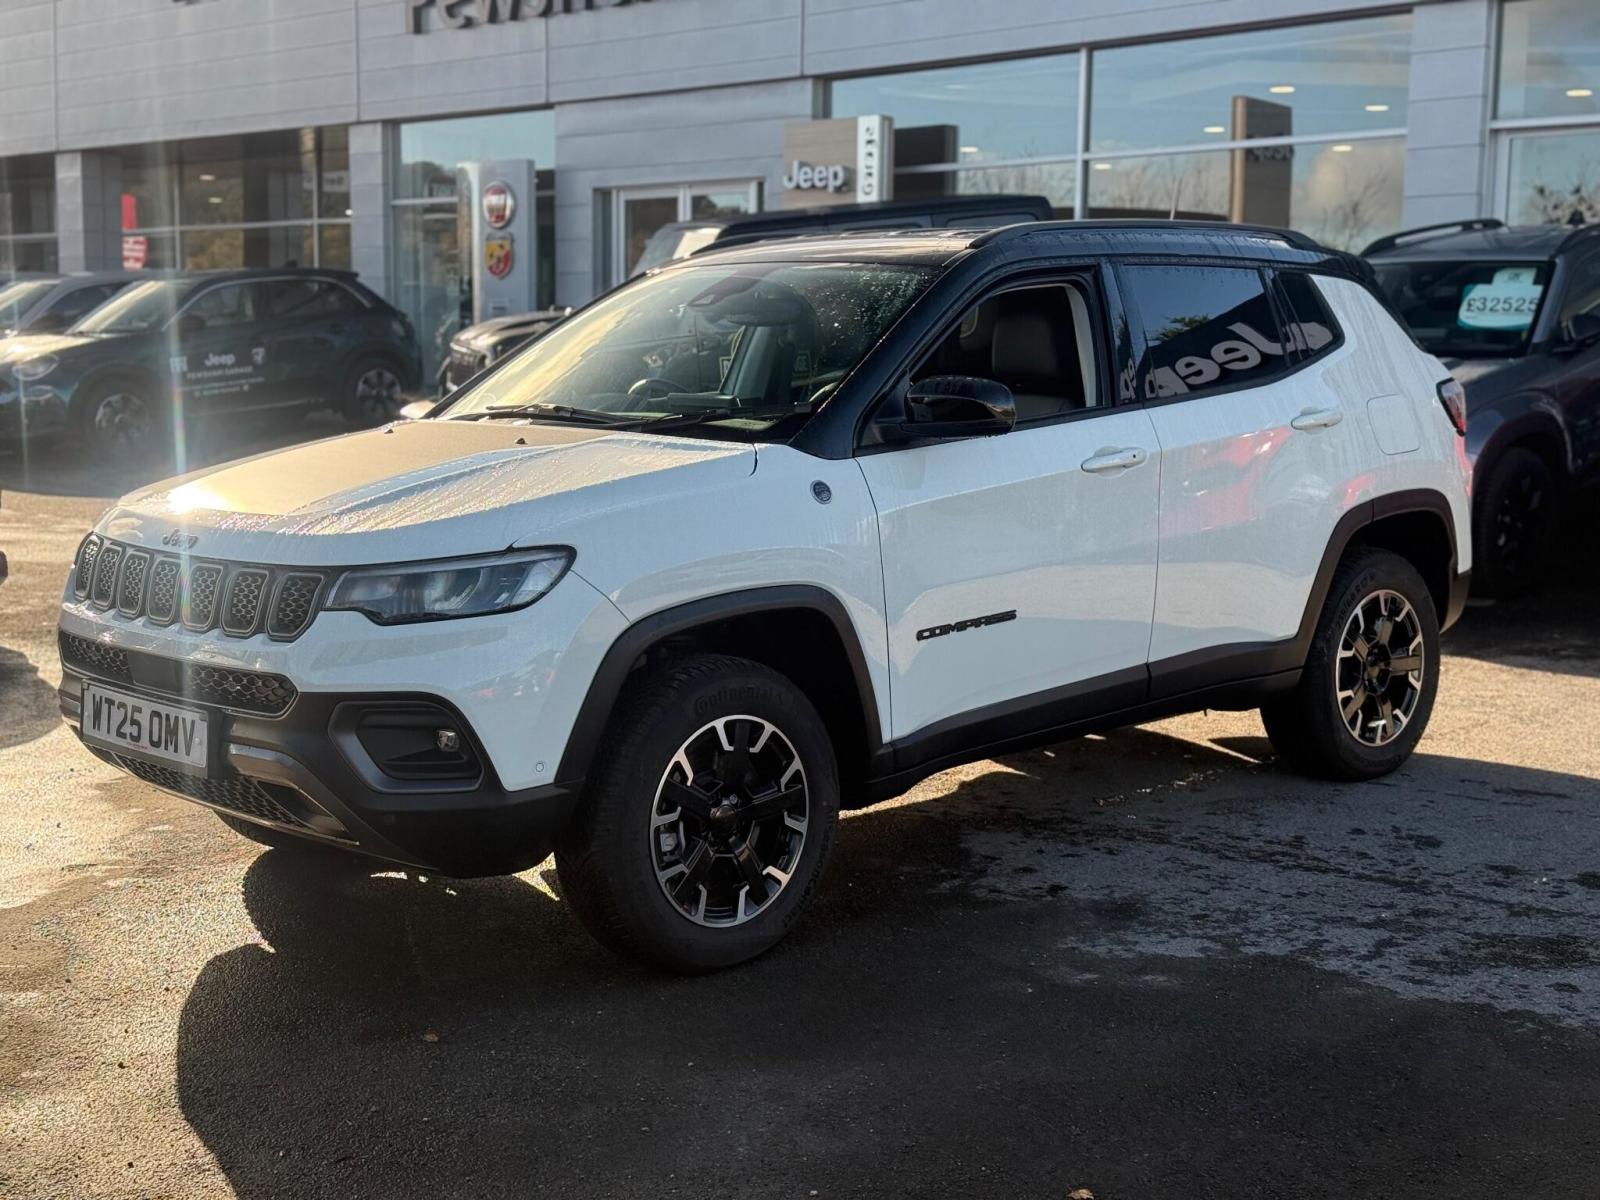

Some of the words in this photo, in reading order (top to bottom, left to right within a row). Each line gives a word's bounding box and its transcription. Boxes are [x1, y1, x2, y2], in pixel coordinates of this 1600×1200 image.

[784, 159, 845, 193] Jeep
[204, 353, 236, 367] Jeep
[916, 609, 1017, 642] COMPASS
[92, 693, 142, 744] WT25
[149, 710, 196, 757] OMV
